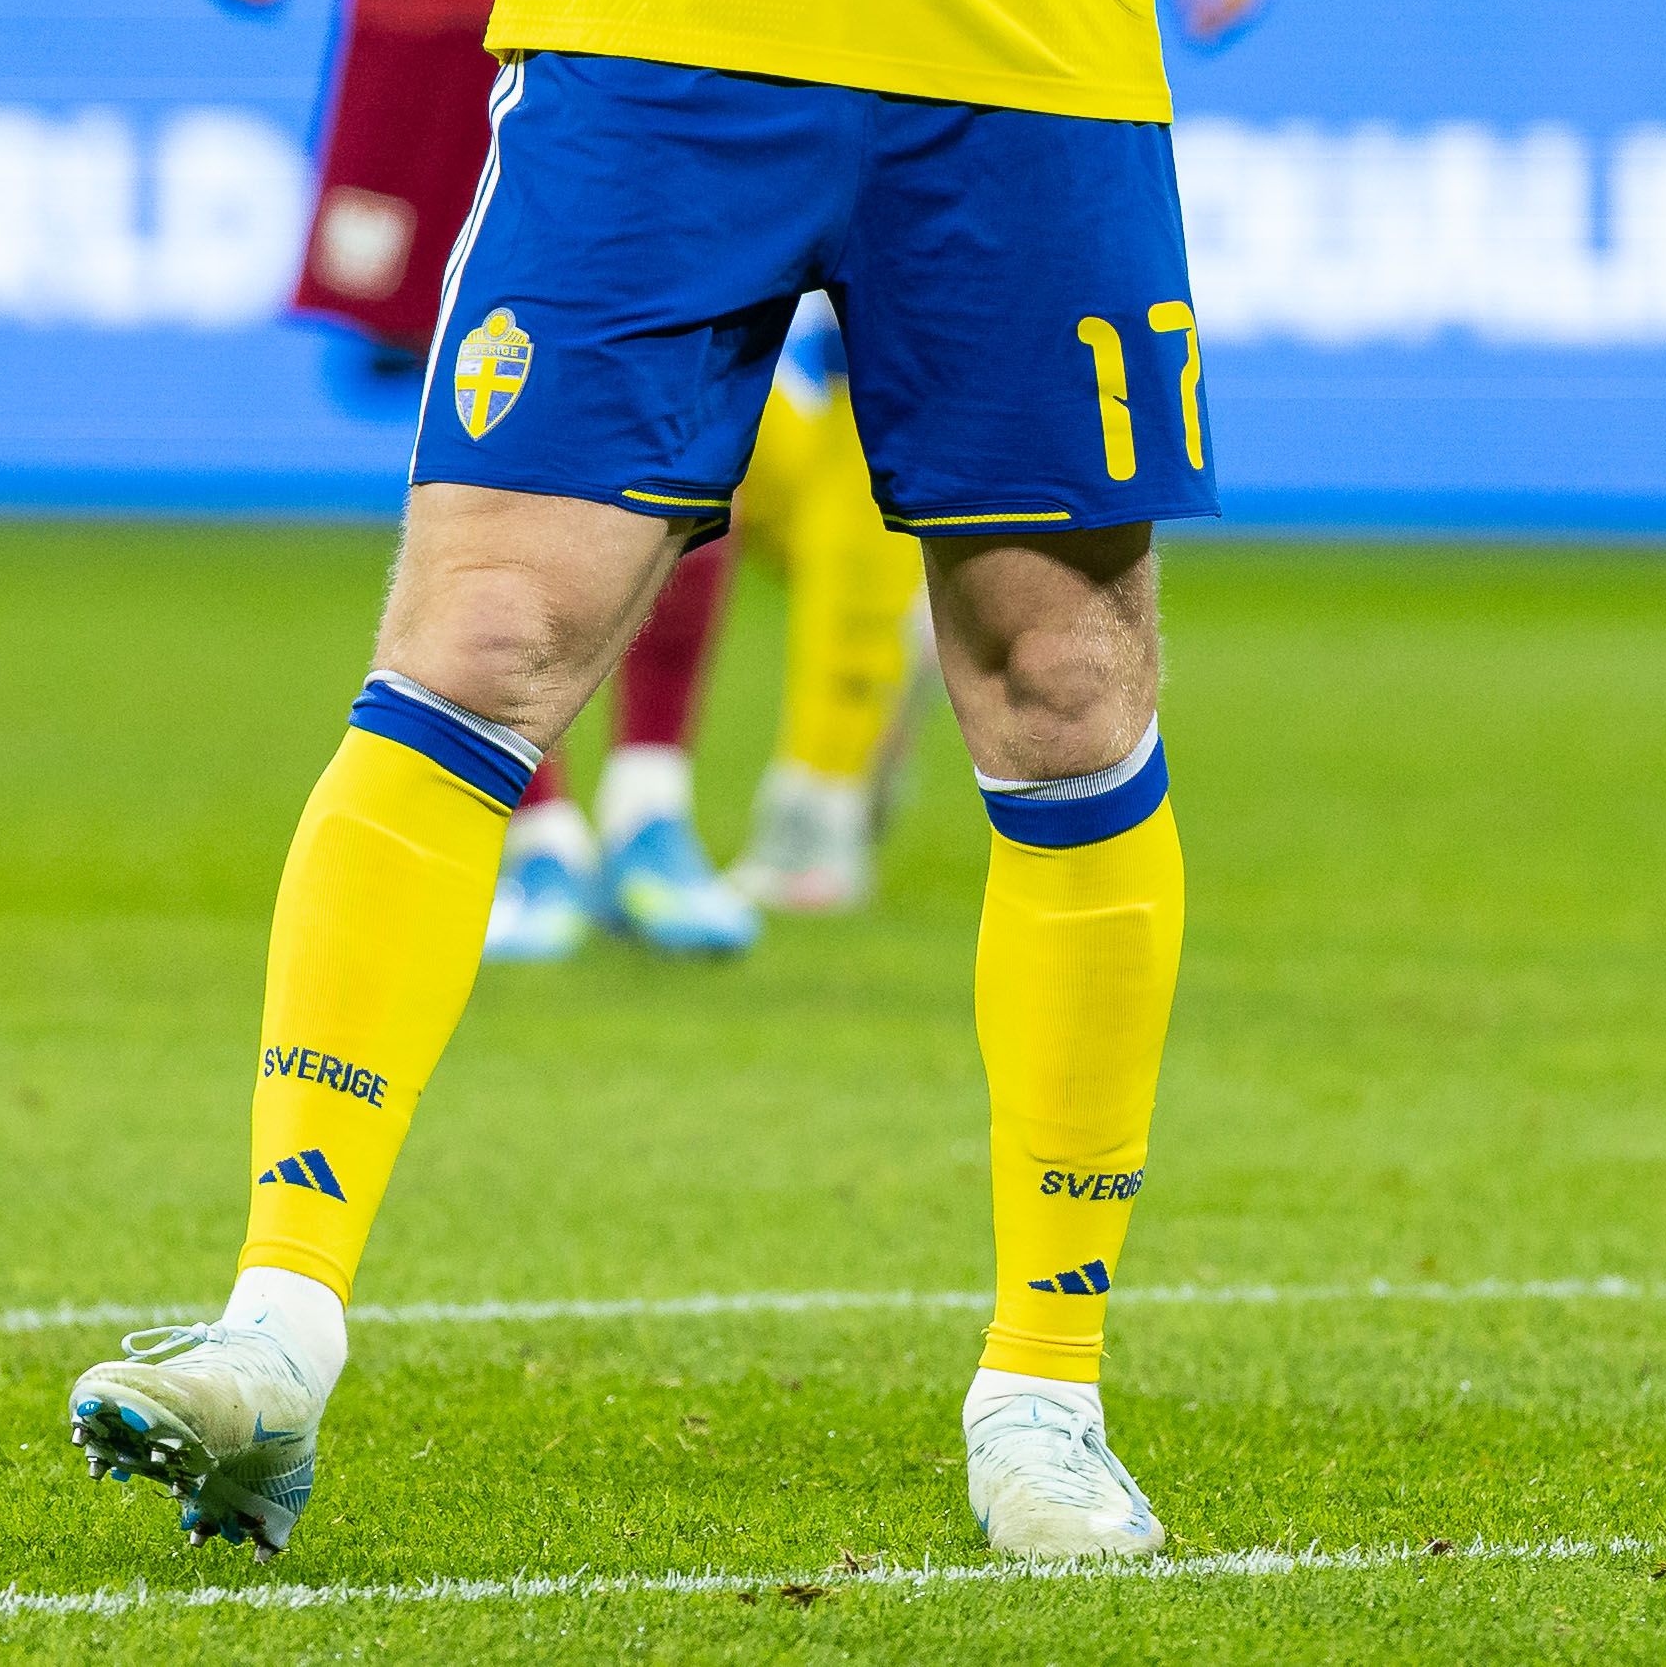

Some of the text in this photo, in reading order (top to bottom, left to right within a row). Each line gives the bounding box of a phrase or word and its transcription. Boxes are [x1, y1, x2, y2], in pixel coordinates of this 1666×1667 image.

[468, 346, 519, 357] SVERIGE
[1077, 300, 1204, 481] 17
[264, 1045, 389, 1109] SVERIGE
